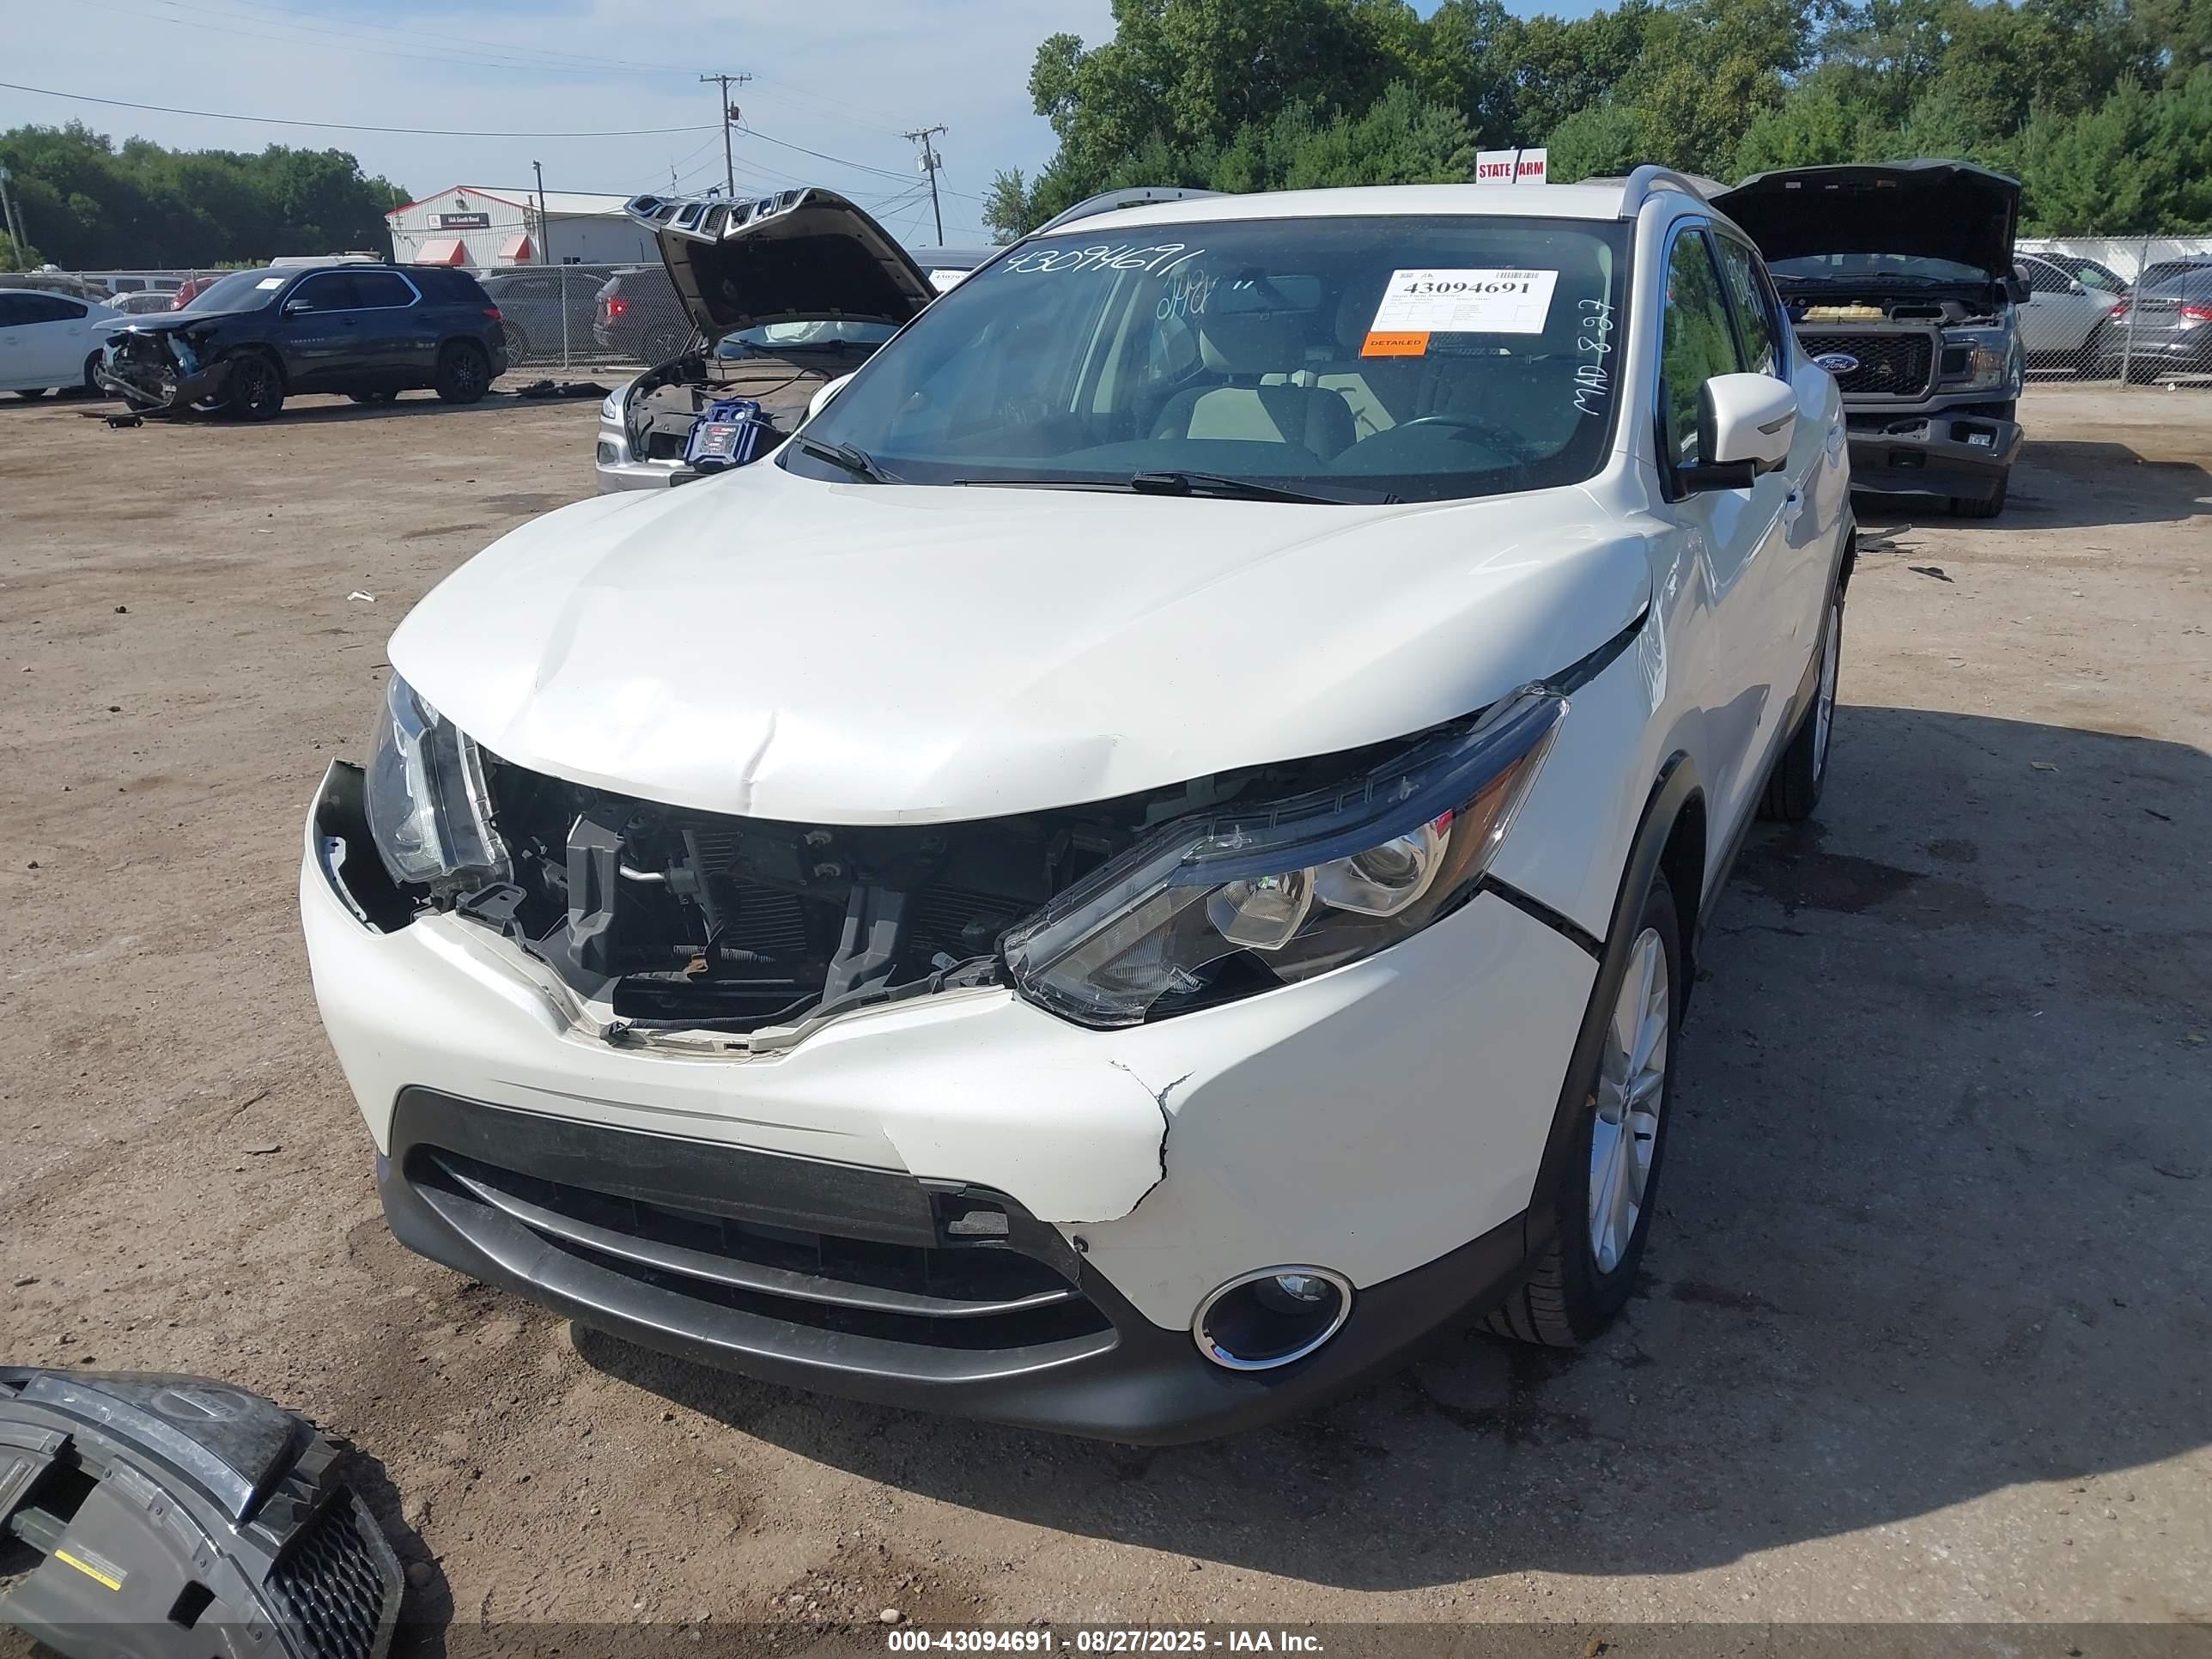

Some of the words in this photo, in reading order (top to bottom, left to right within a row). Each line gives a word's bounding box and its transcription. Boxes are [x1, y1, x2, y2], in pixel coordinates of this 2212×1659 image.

[1479, 163, 1511, 178] STATE
[1514, 161, 1544, 176] ARM
[1001, 243, 1206, 278] 43094691
[1402, 282, 1529, 294] 43094691
[1824, 358, 1848, 369] Ford
[1574, 365, 1608, 416] MAD
